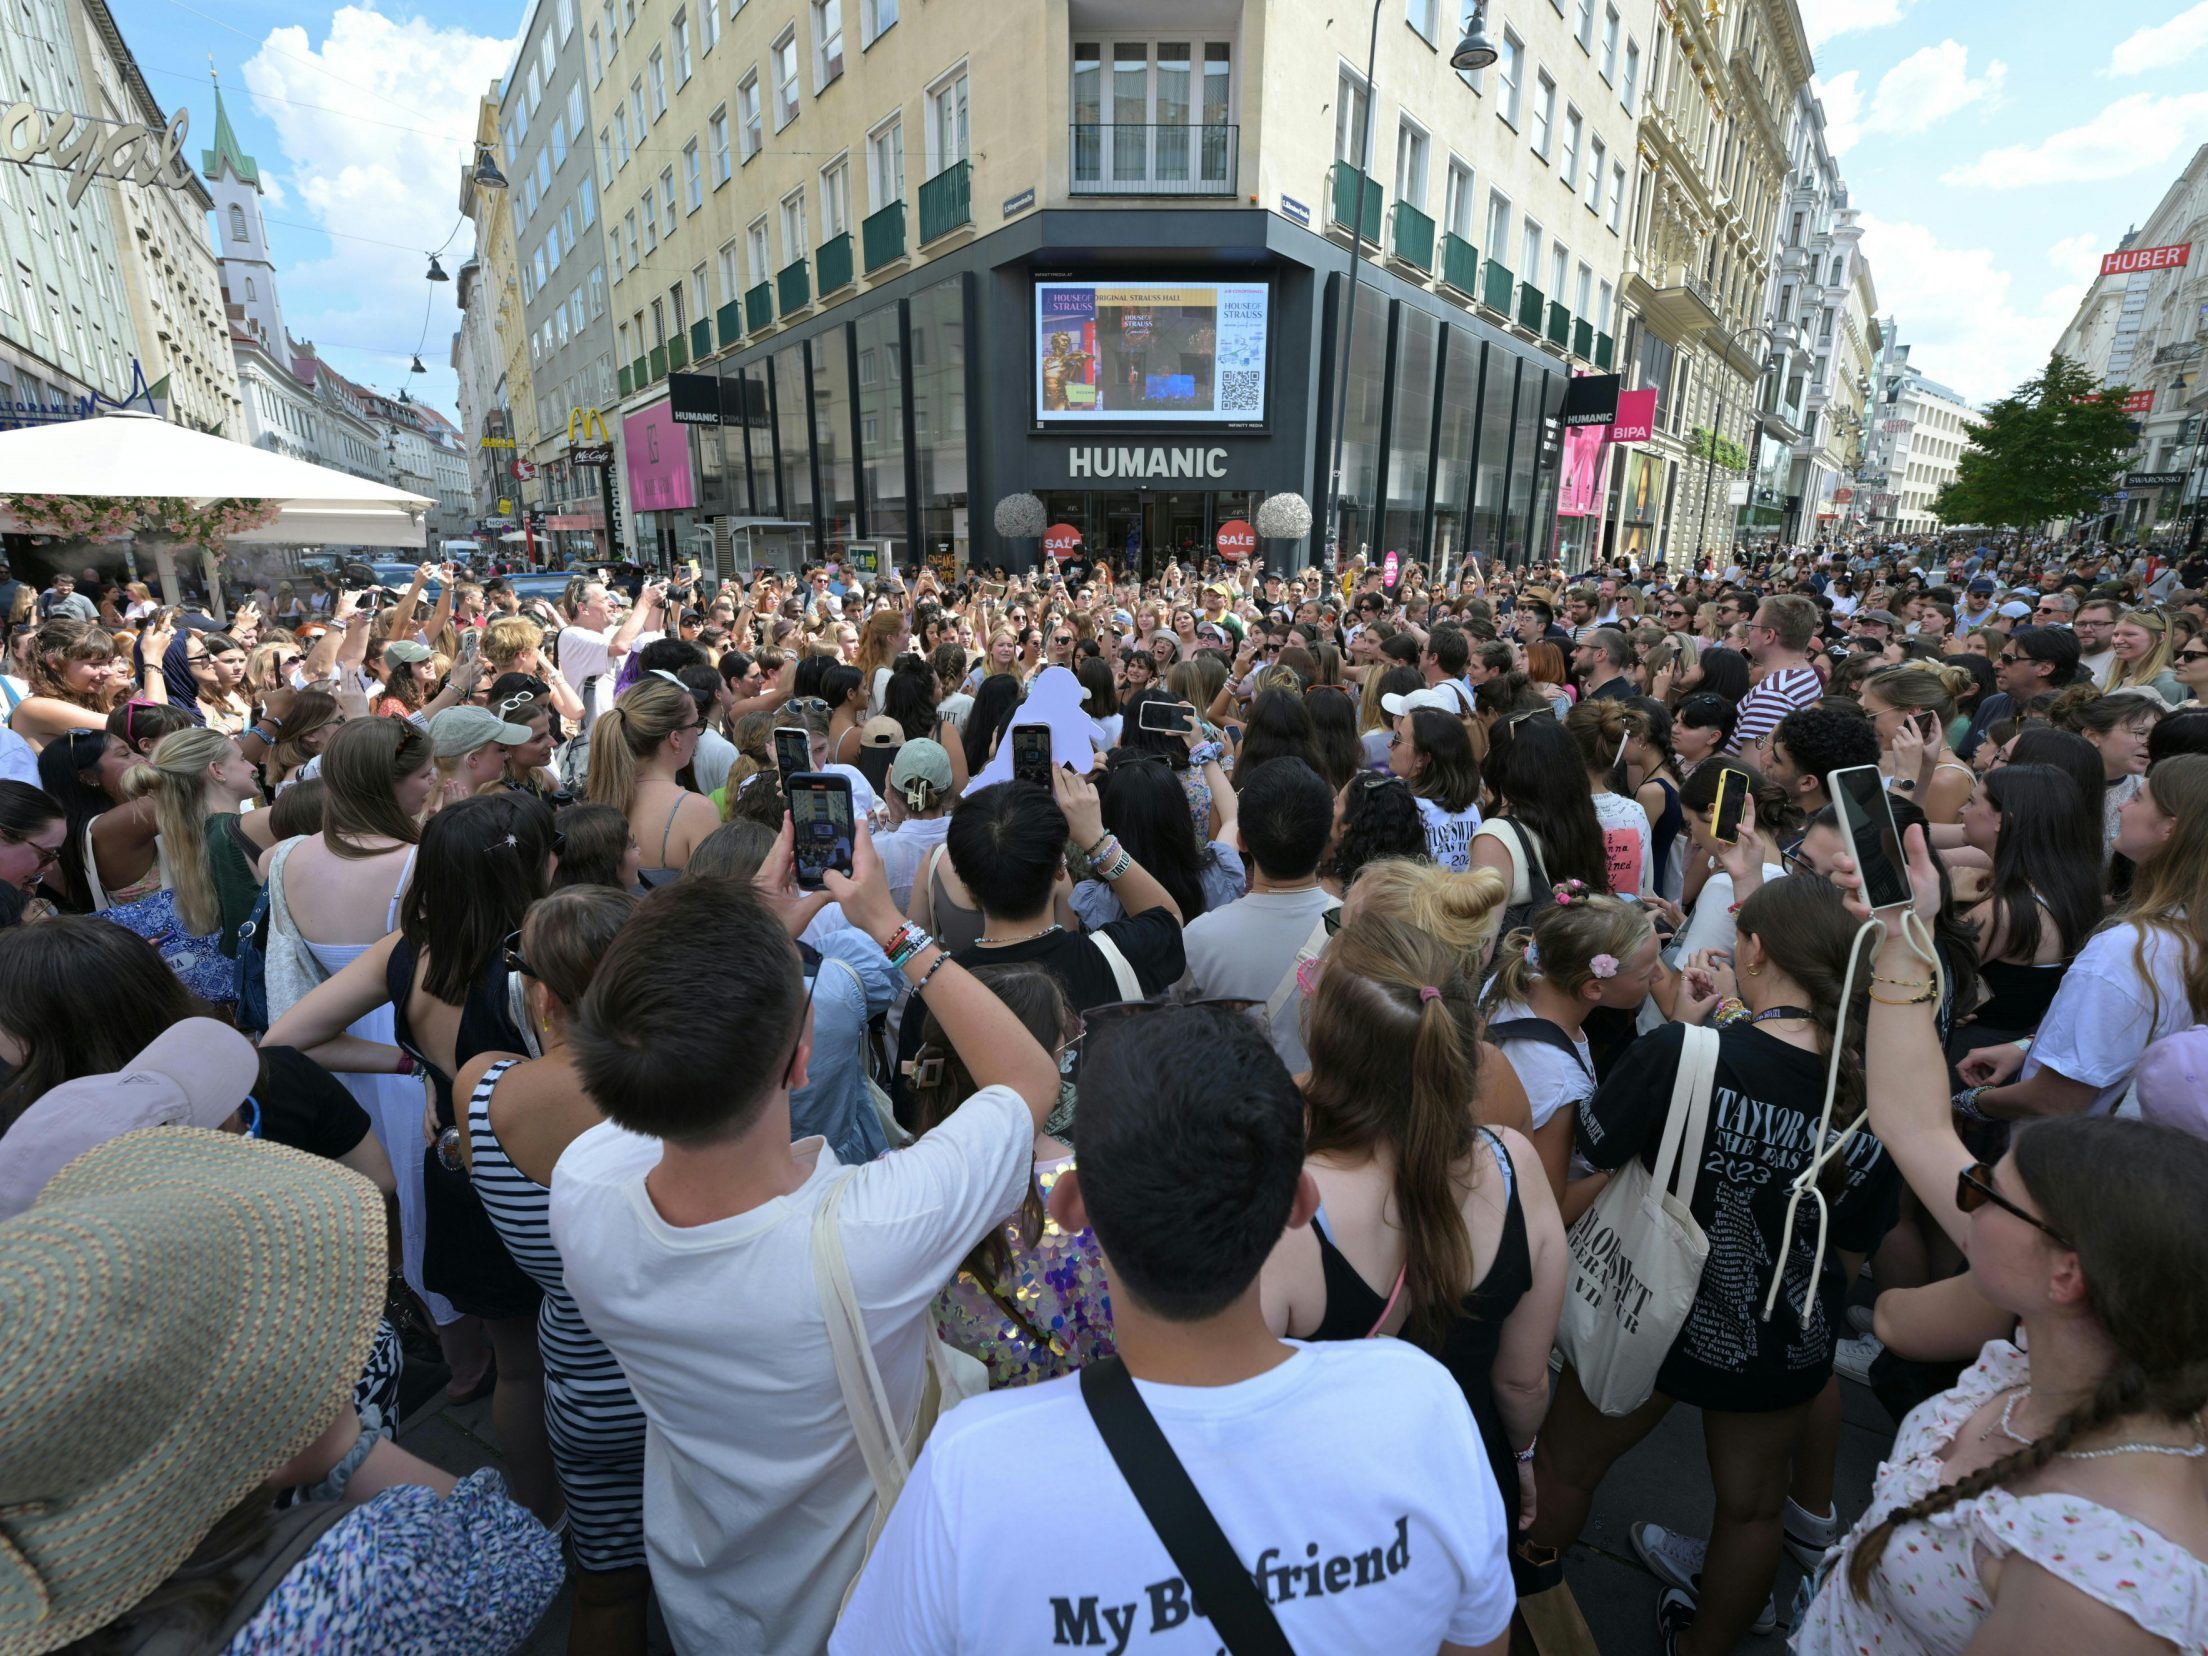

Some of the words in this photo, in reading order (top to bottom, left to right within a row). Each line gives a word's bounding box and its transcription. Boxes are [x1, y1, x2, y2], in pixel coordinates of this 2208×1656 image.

[2105, 247, 2181, 272] HUBER
[1053, 303, 1093, 311] STRAUSS
[675, 411, 718, 422] HUMANIC
[1568, 413, 1613, 424] HUMANIC
[1613, 426, 1647, 438] BIPA
[1069, 447, 1228, 478] HUMANIC
[2129, 476, 2181, 484] SWAROVSKI
[1451, 821, 1477, 842] SWIF
[1715, 1086, 1804, 1149] TAYLOR
[1715, 1127, 1757, 1155] THE
[1049, 1596, 1137, 1656] My
[1145, 1515, 1411, 1634] Bfriend
